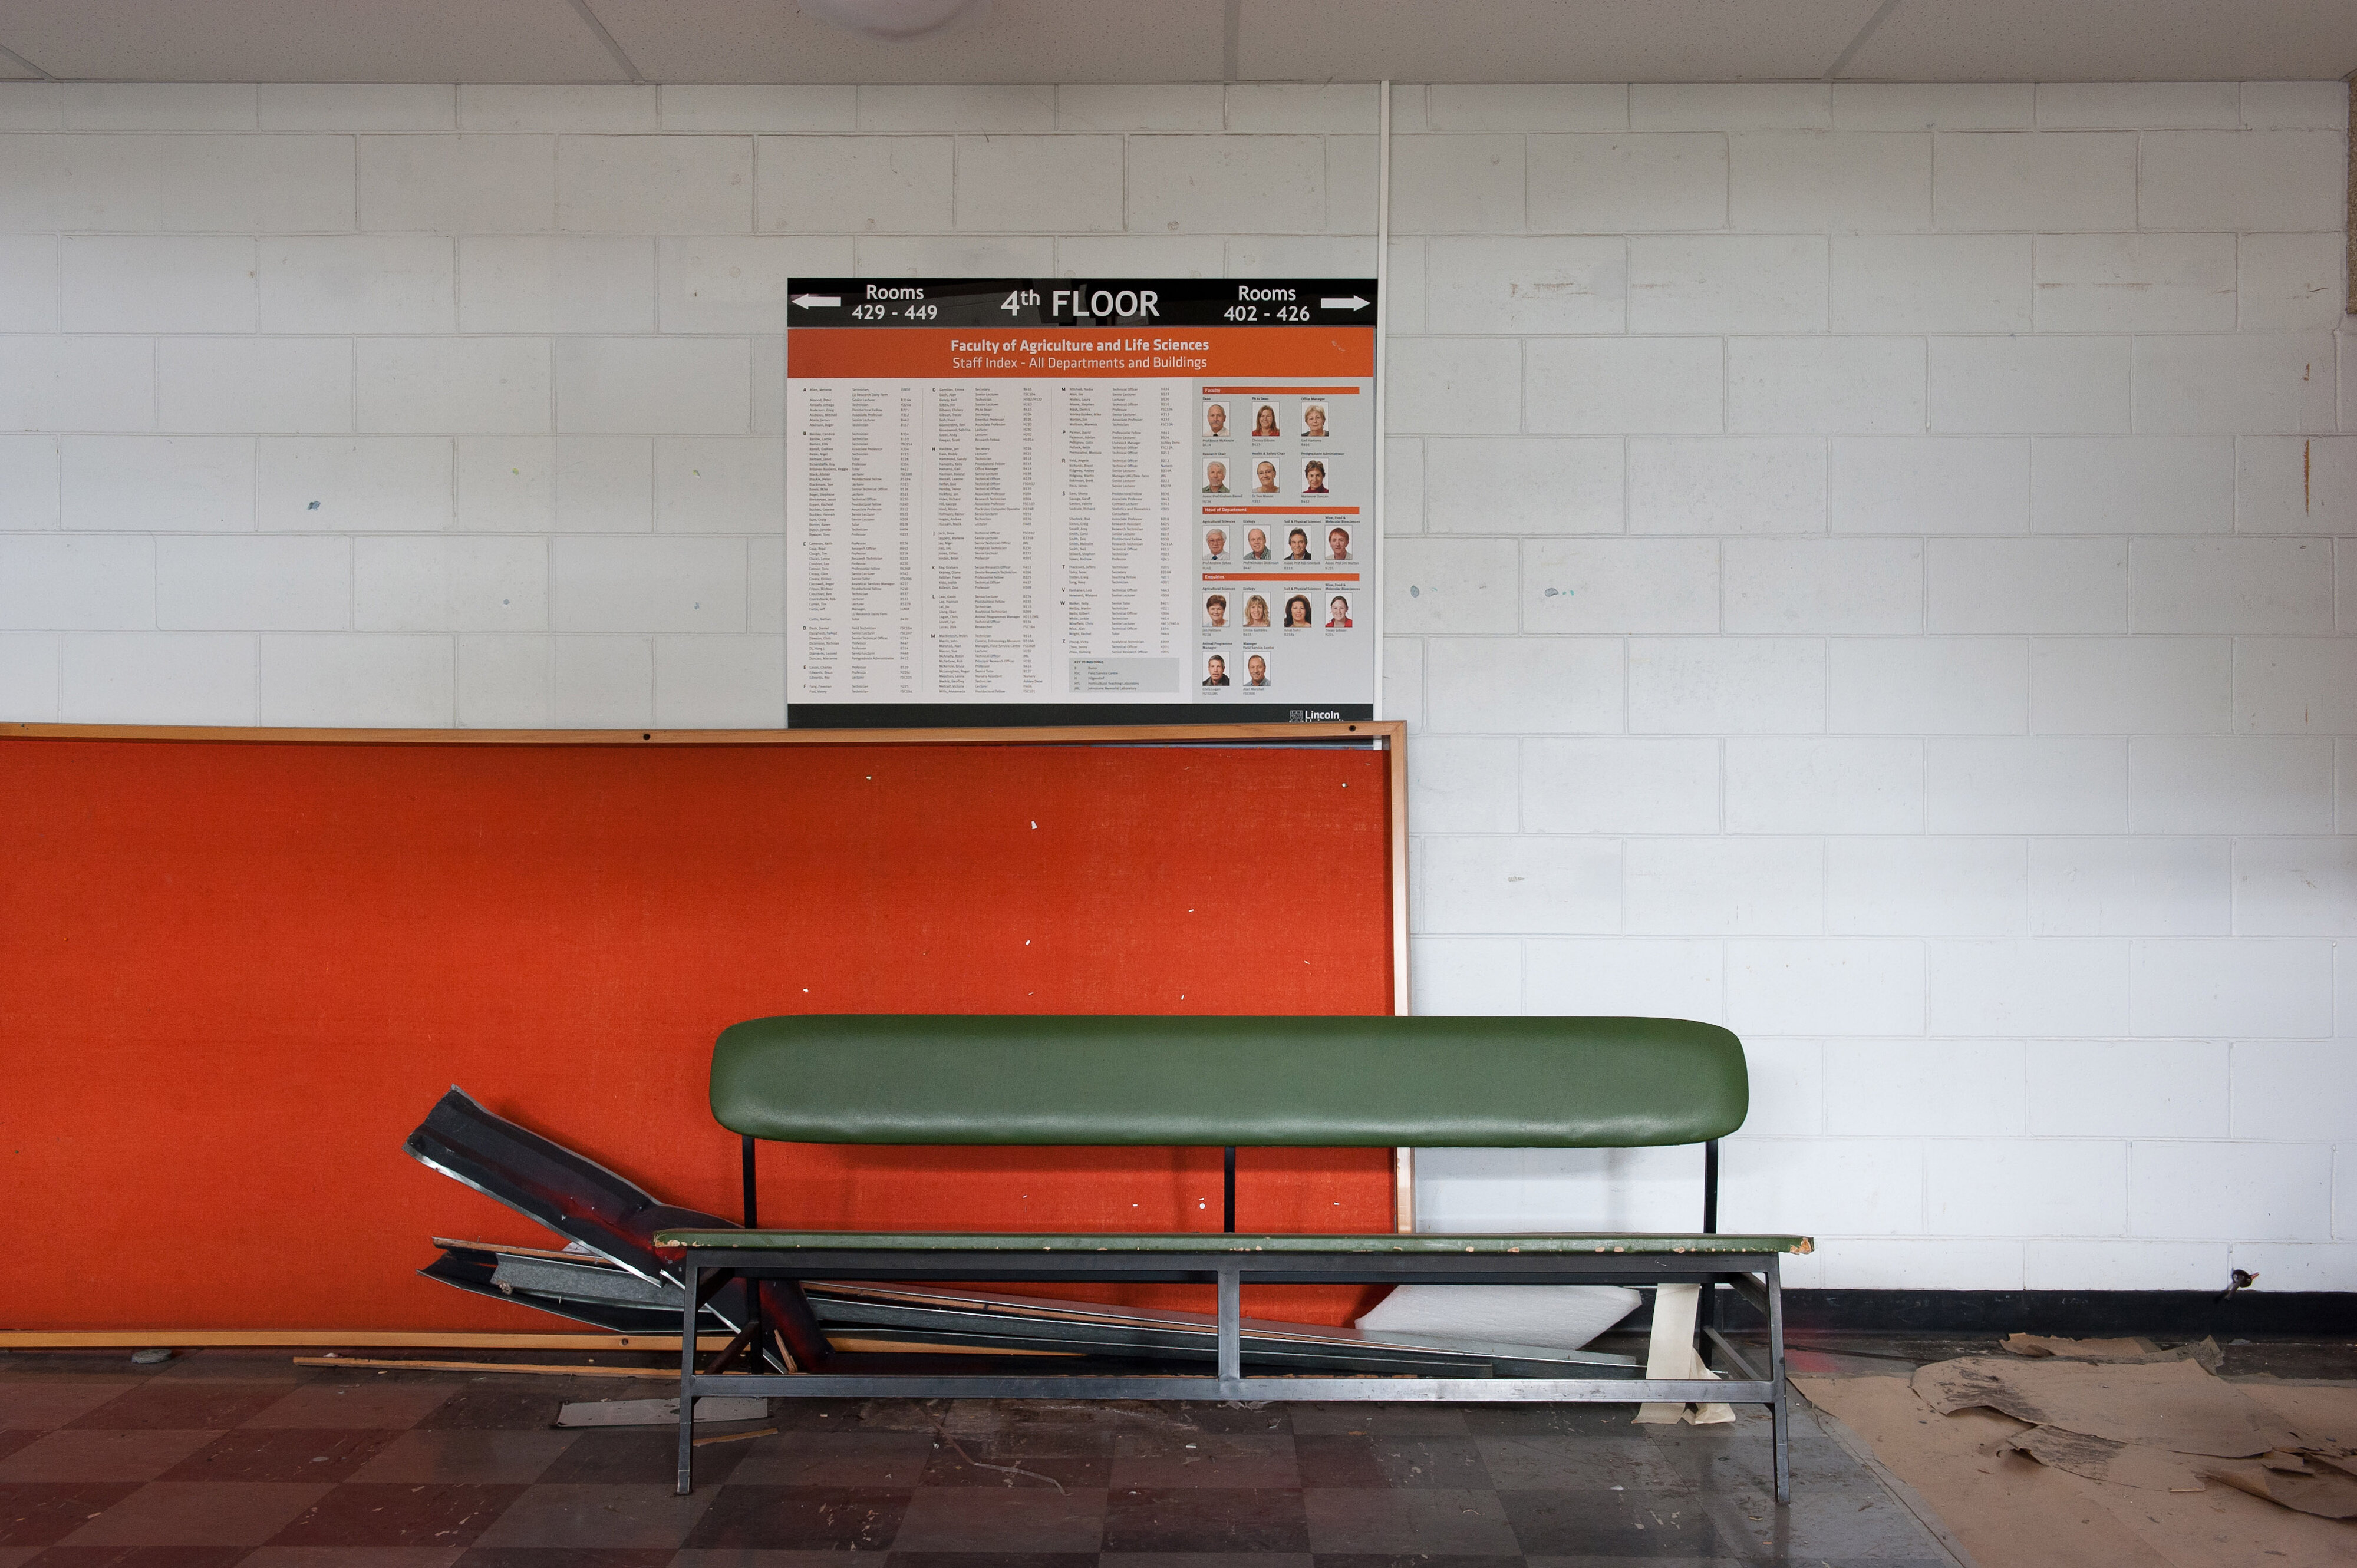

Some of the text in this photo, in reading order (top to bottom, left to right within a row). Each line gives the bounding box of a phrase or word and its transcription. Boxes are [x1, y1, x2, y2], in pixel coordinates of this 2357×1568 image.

[867, 285, 924, 299] Rooms
[1239, 286, 1296, 301] Rooms
[1001, 289, 1160, 316] 4th FLOOR
[852, 305, 885, 319] 429
[905, 305, 937, 319] 449
[1224, 306, 1257, 321] 402
[1277, 306, 1310, 321] 426
[952, 339, 1209, 354] Faculty of Agriculture and Life Sciences
[953, 357, 982, 368] Staff
[986, 357, 1017, 368] Index
[1029, 357, 1044, 368] All
[1049, 358, 1124, 370] Departments
[1129, 356, 1149, 368] and
[1154, 356, 1206, 370] Buildings
[1306, 711, 1339, 719] Lincoln
